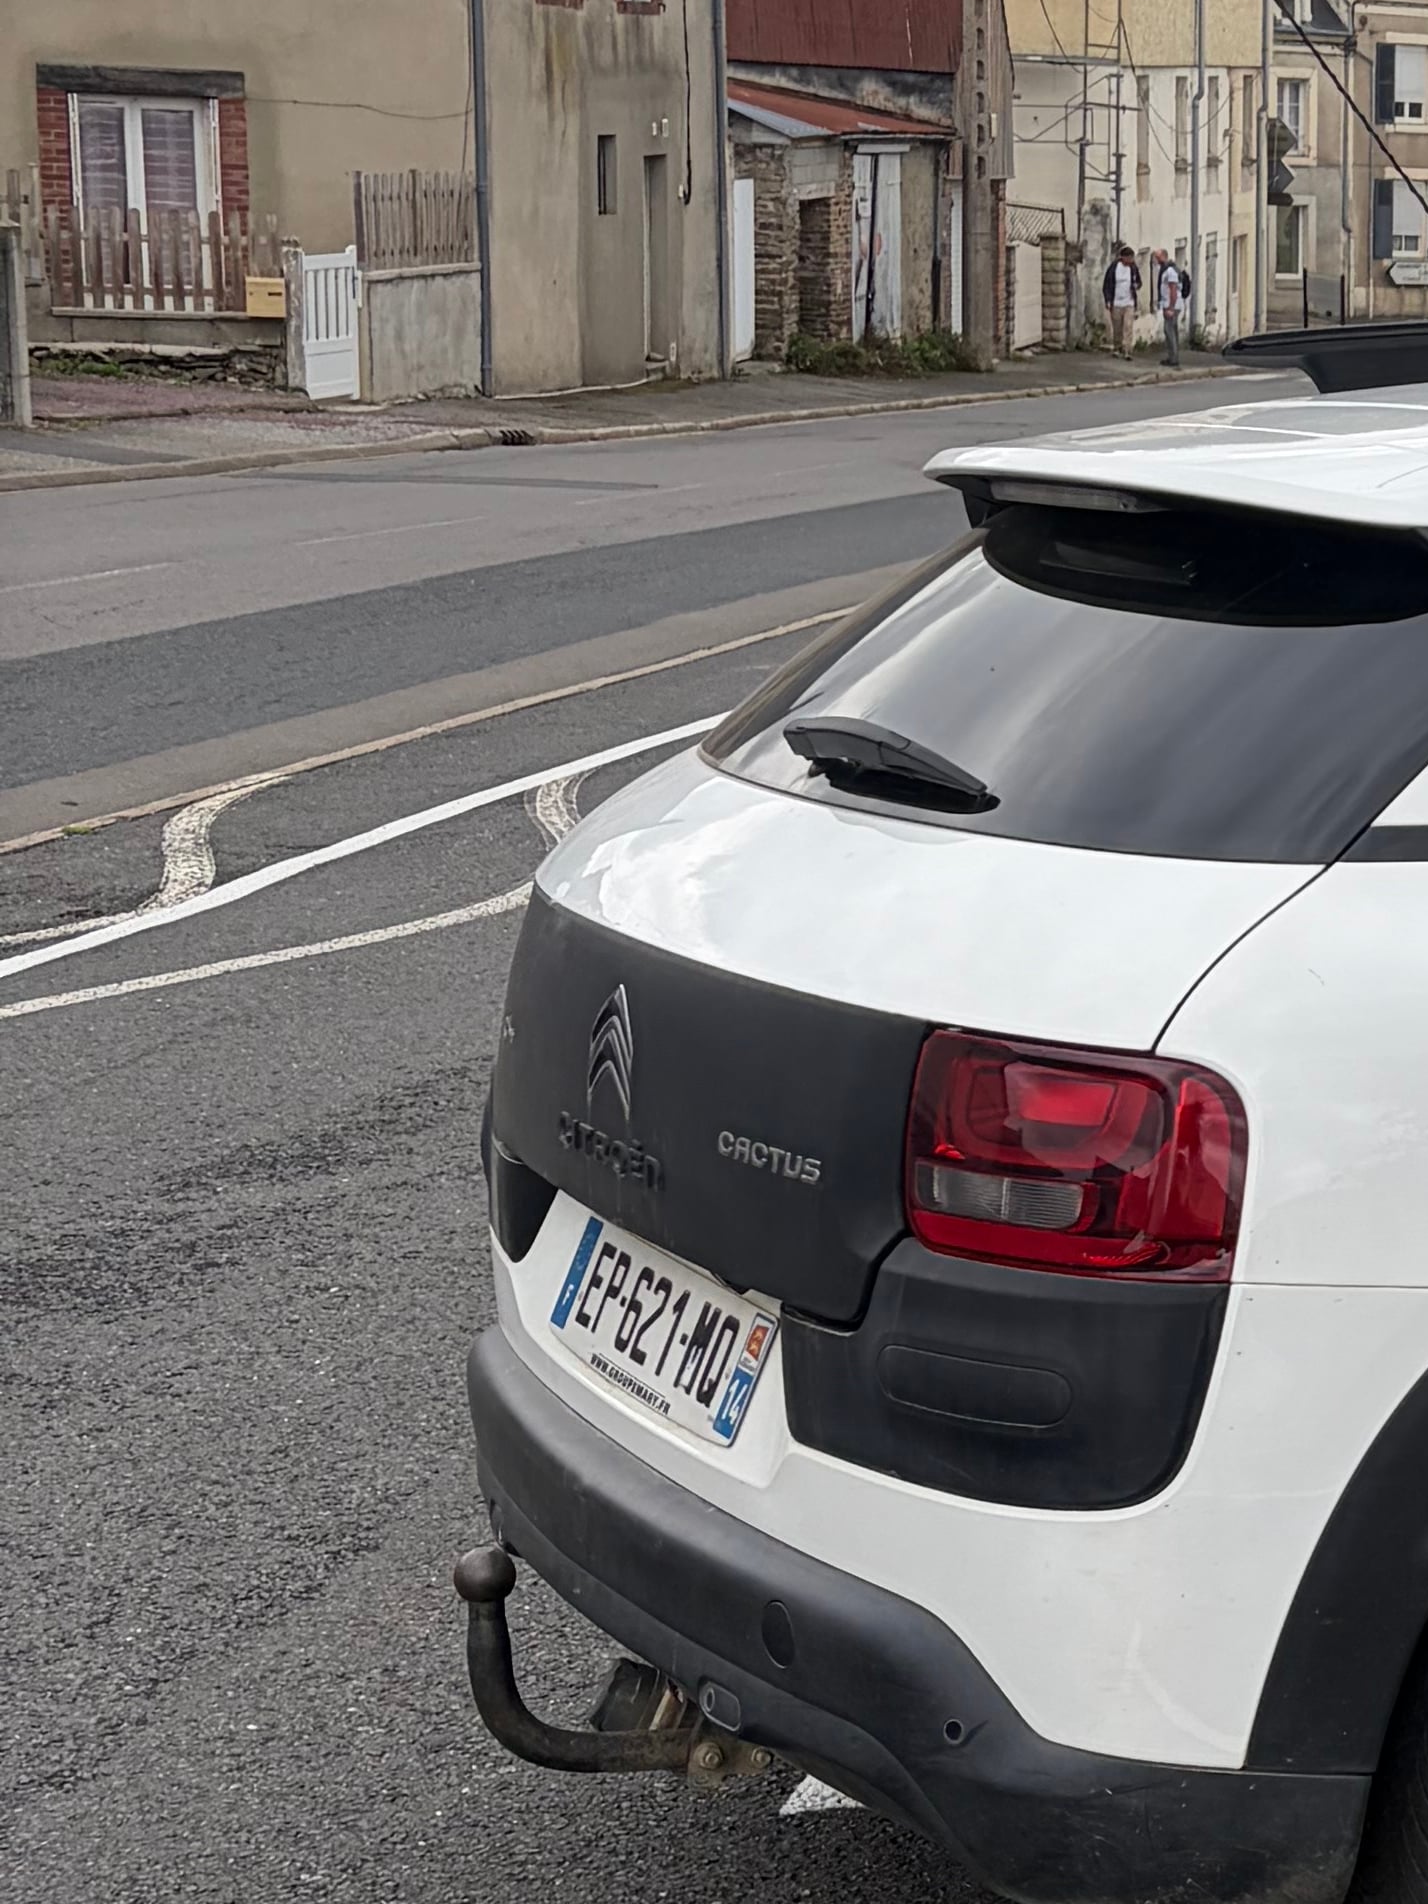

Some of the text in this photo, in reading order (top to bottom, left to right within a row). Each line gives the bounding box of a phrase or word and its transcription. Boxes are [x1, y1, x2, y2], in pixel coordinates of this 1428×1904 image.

[716, 1129, 823, 1185] CACTUS
[562, 1283, 575, 1306] F
[574, 1241, 741, 1409] EP-621-MQ
[721, 1377, 750, 1426] 14
